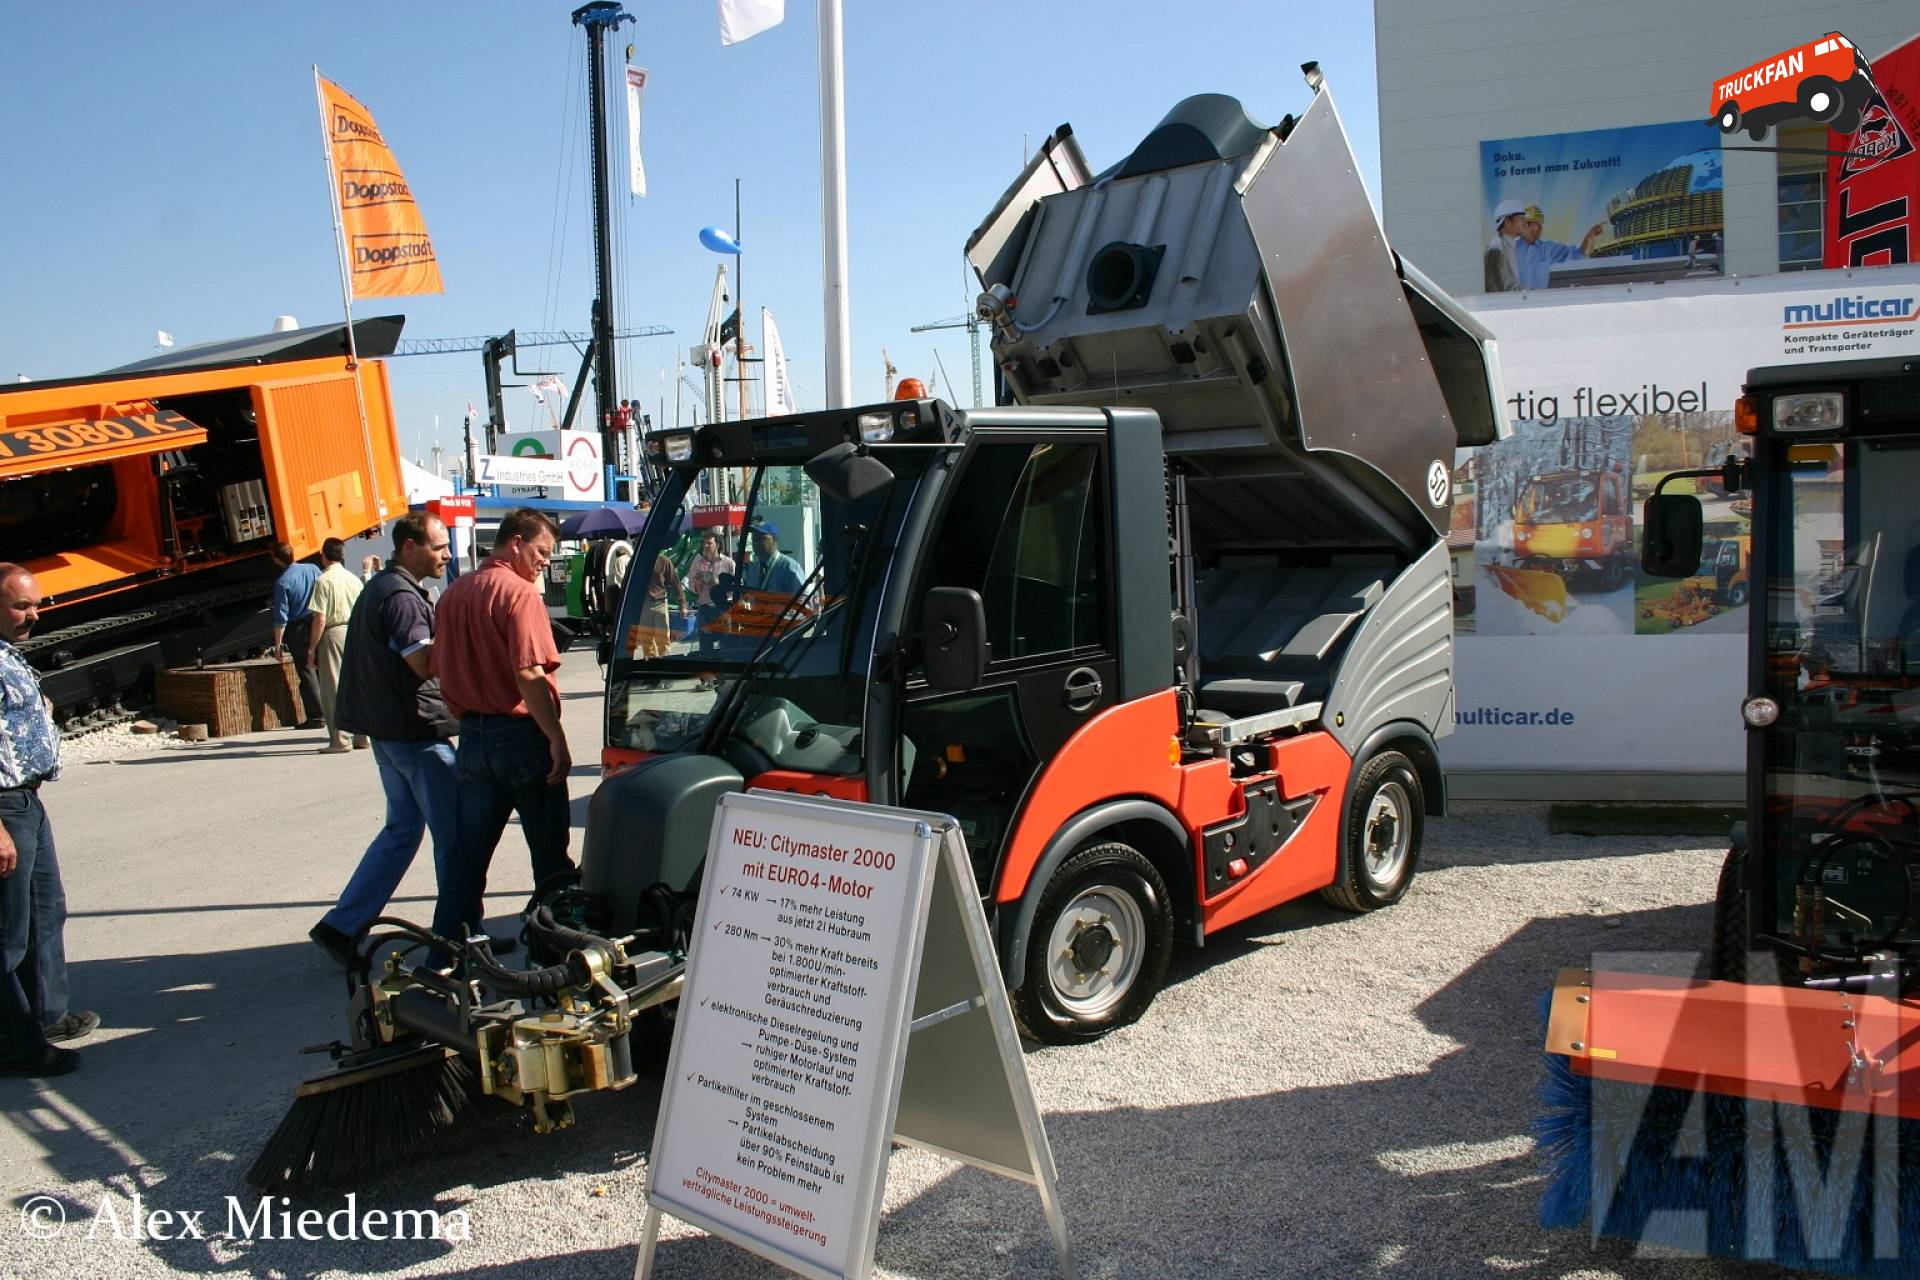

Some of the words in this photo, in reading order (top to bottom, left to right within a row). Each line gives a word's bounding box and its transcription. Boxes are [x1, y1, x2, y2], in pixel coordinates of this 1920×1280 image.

[1494, 151, 1526, 163] Doka.
[1494, 167, 1507, 177] So
[1510, 165, 1541, 176] formt
[1545, 163, 1569, 173] man
[1572, 156, 1621, 171] Zukunft!
[1784, 296, 1914, 323] multicar
[1784, 332, 1839, 343] Kompakte
[1842, 329, 1915, 341] Geräteträger
[1784, 346, 1805, 354] und
[1808, 343, 1872, 354] Transporter
[1573, 381, 1707, 417] flexibel
[14, 420, 135, 452] 3080
[539, 470, 564, 483] GmbH
[733, 828, 767, 849] NEU:
[770, 834, 849, 863] Citymaster
[853, 848, 896, 871] 2000
[742, 860, 765, 879] mit
[731, 887, 742, 899] 74
[744, 890, 760, 902] KW
[780, 898, 797, 911] 17%
[800, 903, 823, 916] mehr
[825, 907, 865, 927] Leistung
[777, 913, 793, 925] aus
[794, 916, 815, 929] jetzt
[828, 923, 871, 942] Hubraum
[725, 924, 742, 937] 280
[744, 928, 759, 941] Nm
[774, 936, 793, 950] 30%
[795, 943, 819, 956] mehr
[821, 946, 844, 962] Kraft
[846, 951, 879, 970] bereits
[772, 951, 786, 963] bei
[767, 981, 811, 1000] verbrauch
[813, 991, 831, 1005] und
[769, 965, 819, 986] optimierter
[820, 977, 868, 999] Kraftstoff-
[711, 1000, 768, 1026] elektronische
[770, 1017, 839, 1047] Dieselregelung
[840, 1037, 860, 1052] und
[764, 993, 862, 1032] Geräuschreduzierung
[753, 1058, 802, 1081] optimierter
[804, 1074, 852, 1097] Kraftstoff-
[755, 1044, 788, 1064] ruhiger
[789, 1052, 834, 1076] Motorlauf
[836, 1068, 854, 1082] und
[751, 1073, 796, 1095] verbrauch
[697, 1074, 749, 1101] Partikelfilter
[750, 1095, 761, 1106] im
[763, 1099, 835, 1132] geschlossenem
[745, 1106, 778, 1127] System
[739, 1136, 760, 1152] über
[762, 1145, 783, 1162] 90%
[785, 1153, 831, 1180] Feinstaub
[832, 1171, 845, 1185] ist
[742, 1120, 835, 1166] Partikelabscheidung
[736, 1152, 756, 1168] kein
[757, 1160, 796, 1184] Problem
[798, 1177, 822, 1194] mehr
[682, 1177, 732, 1206] verträgliche
[733, 1198, 827, 1247] Leistungssteigerung
[695, 1167, 743, 1193] Citymaster
[744, 1185, 769, 1205] 2000
[779, 1202, 816, 1223] umwelt-
